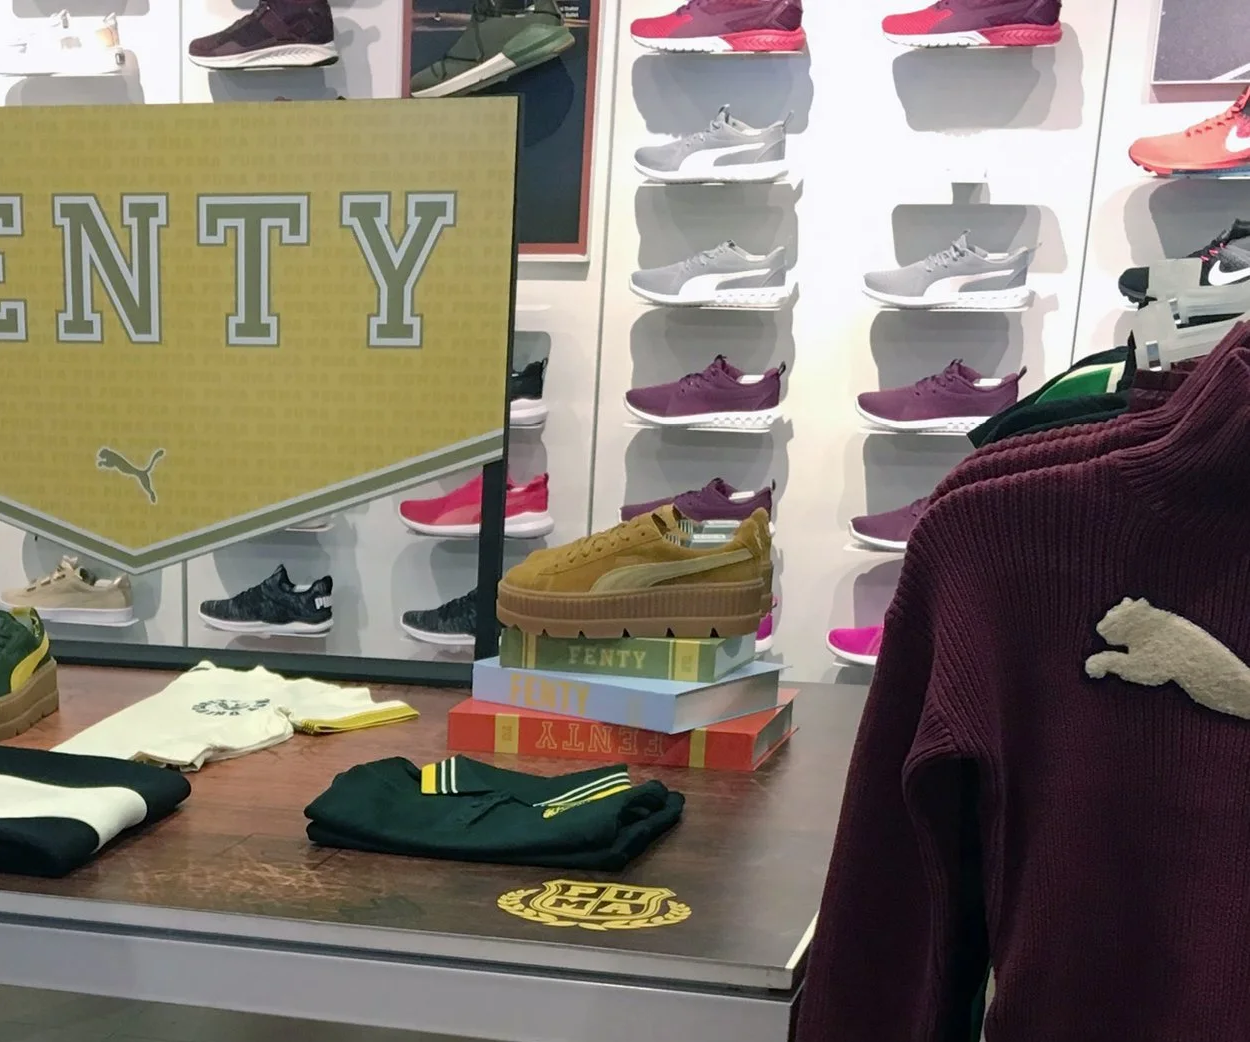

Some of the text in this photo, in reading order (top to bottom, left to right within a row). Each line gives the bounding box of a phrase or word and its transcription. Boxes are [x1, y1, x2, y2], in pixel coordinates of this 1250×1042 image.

[568, 645, 646, 669] FENTY
[509, 673, 590, 716] FENTY
[535, 721, 664, 757] FENTY
